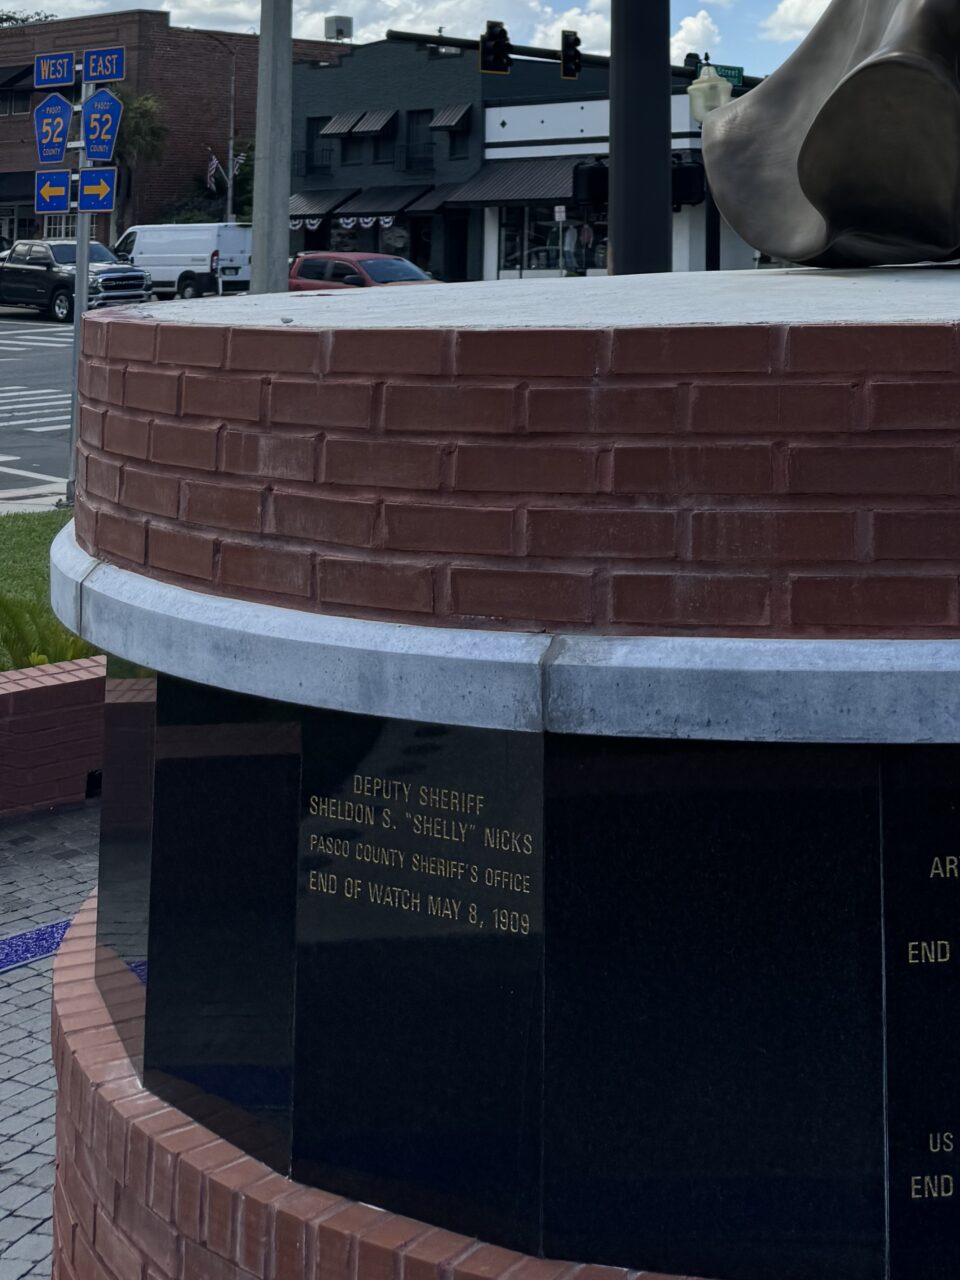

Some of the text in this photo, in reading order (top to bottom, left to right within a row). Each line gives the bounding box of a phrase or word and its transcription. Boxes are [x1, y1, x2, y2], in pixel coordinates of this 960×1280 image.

[40, 58, 69, 80] WEST
[90, 54, 118, 76] EAST
[42, 117, 63, 144] 52
[89, 113, 112, 140] 52
[43, 148, 61, 156] COUNTY
[90, 145, 109, 153] COUNTY
[353, 775, 485, 816] DEPUTY SHERIFF
[309, 796, 375, 825] SHELDON
[382, 809, 396, 830] S.
[484, 828, 533, 854] NICKS
[310, 834, 350, 857] PASCO
[355, 843, 405, 868] COUNTY
[485, 868, 530, 894] OFFICE
[309, 871, 530, 935] END OF WATCH MAY 8, 1909
[908, 940, 950, 964] END
[929, 1131, 954, 1152] US
[911, 1175, 954, 1199] END
